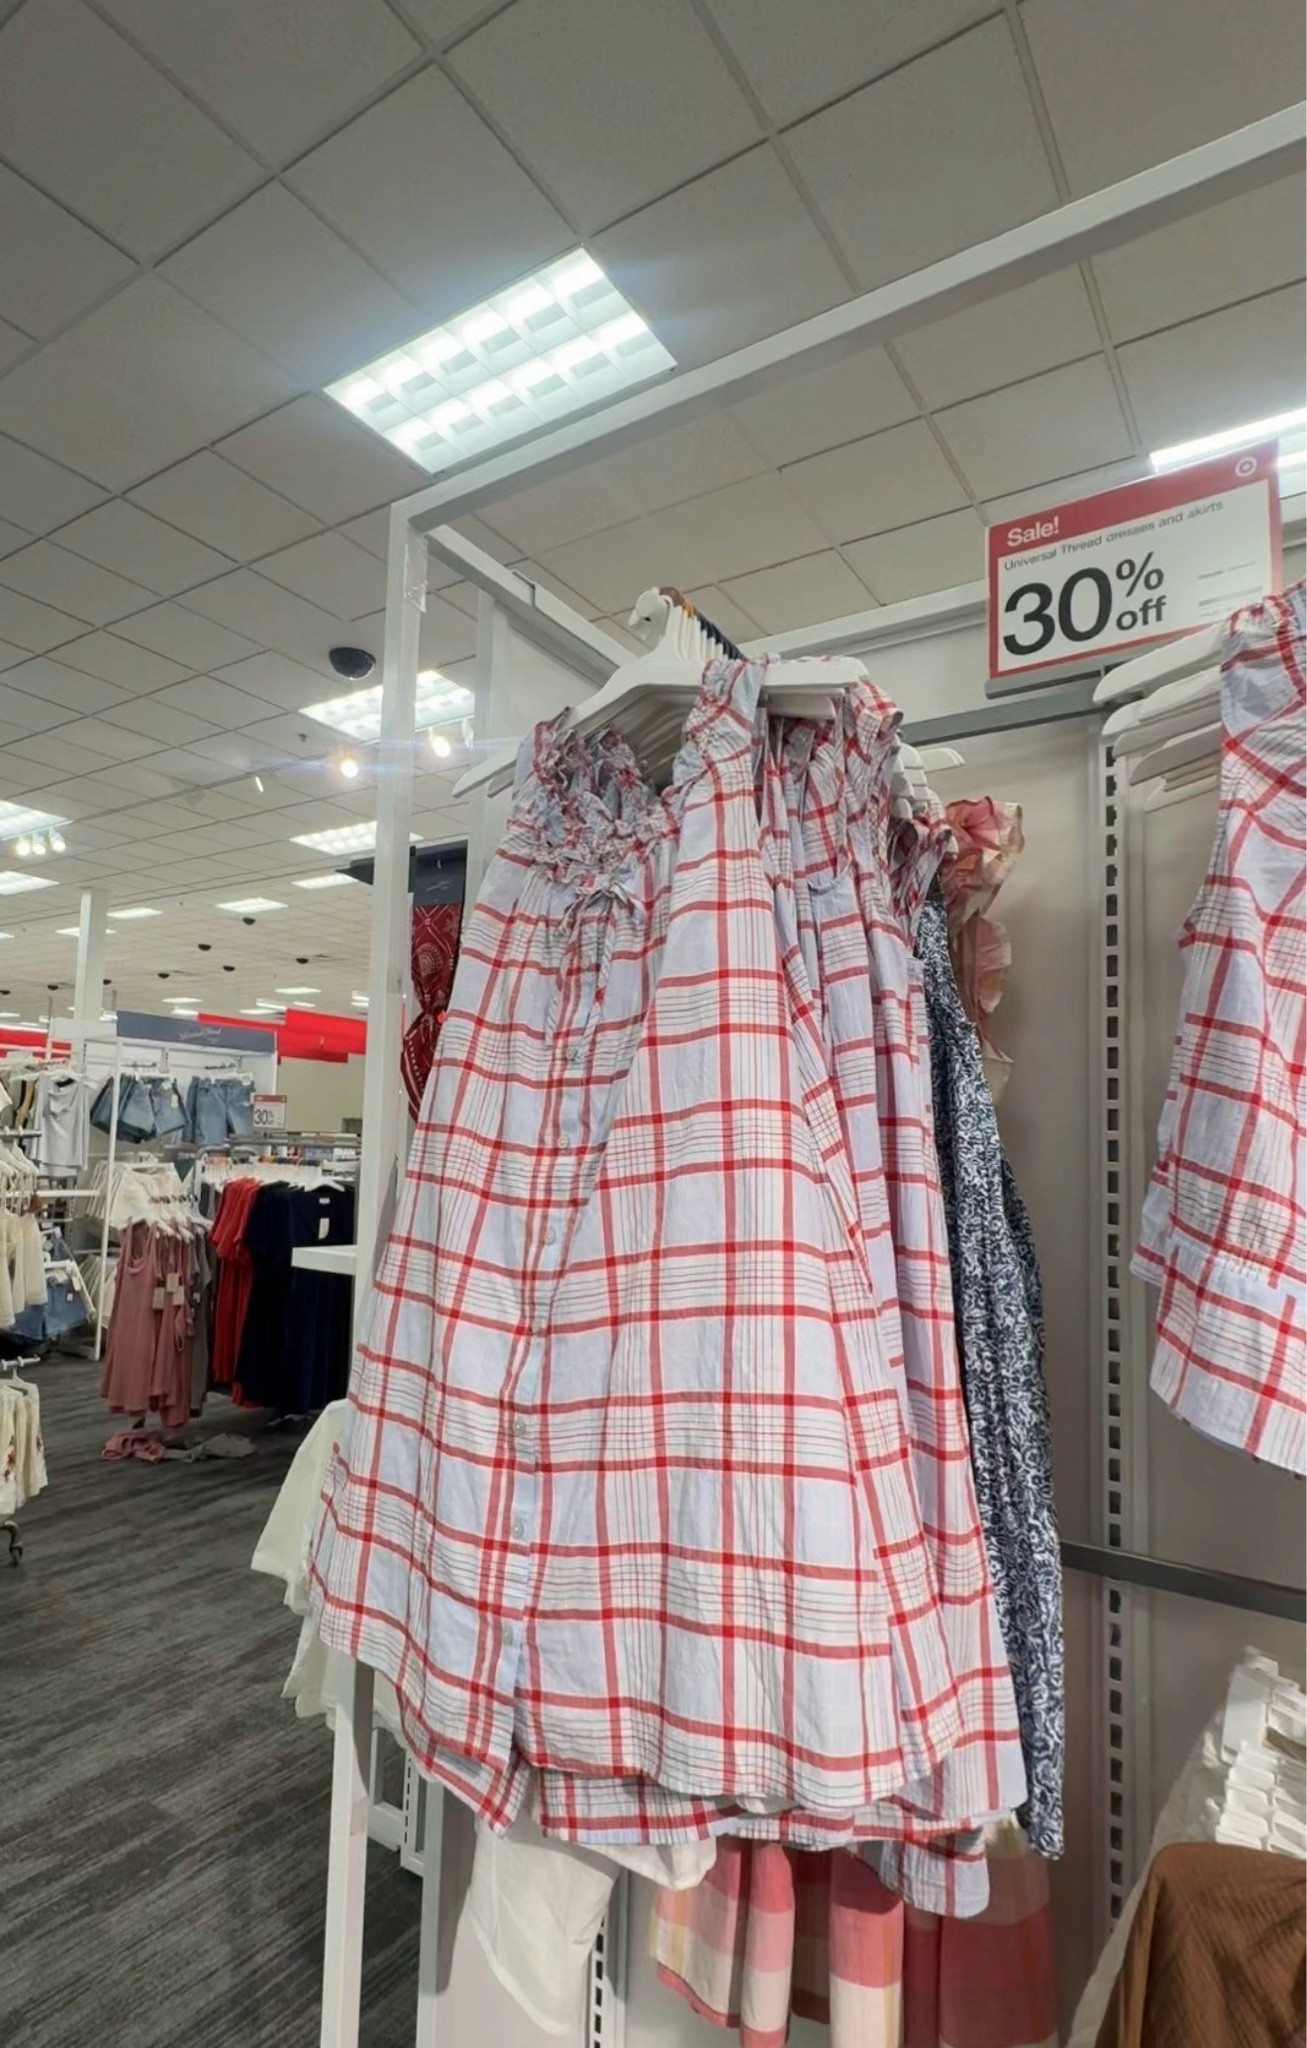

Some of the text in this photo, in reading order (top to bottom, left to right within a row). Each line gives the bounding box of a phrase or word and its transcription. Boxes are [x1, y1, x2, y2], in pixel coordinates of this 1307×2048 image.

[1004, 501, 1224, 571] Universal Thread dresses and skirts
[1007, 516, 1060, 547] Sale!
[1003, 551, 1164, 655] 30%
[1116, 595, 1167, 631] off
